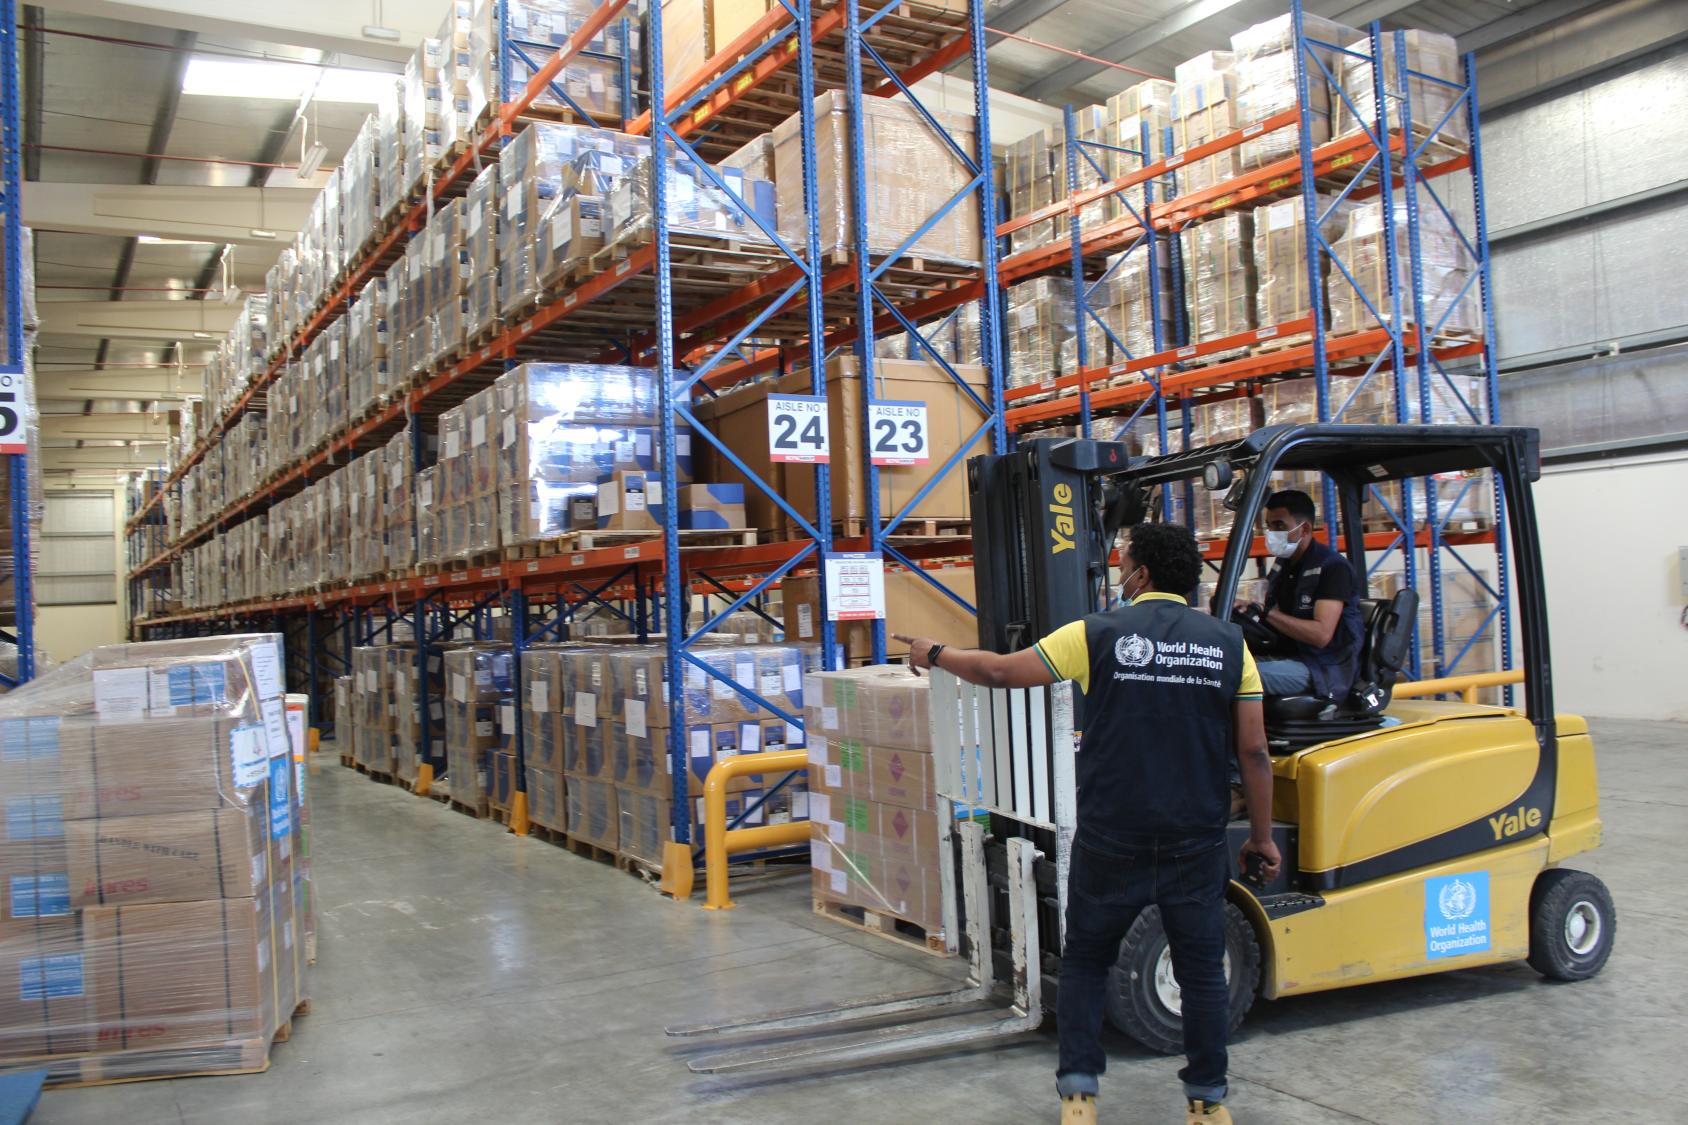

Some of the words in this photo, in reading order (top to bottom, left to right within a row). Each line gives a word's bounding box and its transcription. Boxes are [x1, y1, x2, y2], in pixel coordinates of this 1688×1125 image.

[0, 376, 12, 387] O
[0, 392, 18, 436] 5
[775, 401, 803, 412] AISLE
[806, 403, 821, 413] NO
[876, 407, 903, 417] AISLE
[905, 408, 920, 417] NO
[773, 414, 825, 450] 24
[874, 419, 924, 453] 23
[1049, 483, 1076, 555] Yale
[1156, 641, 1186, 654] World
[1189, 643, 1224, 658] Health
[1155, 653, 1223, 670] Organization
[1113, 671, 1155, 682] Organisation
[1156, 674, 1185, 684] mondiale
[1186, 676, 1195, 684] de
[1195, 676, 1202, 685] la
[1203, 677, 1222, 688] Santé
[1488, 806, 1542, 841] Yale
[1430, 925, 1456, 938] World
[1458, 919, 1487, 934] Health
[1430, 934, 1487, 953] Organization
